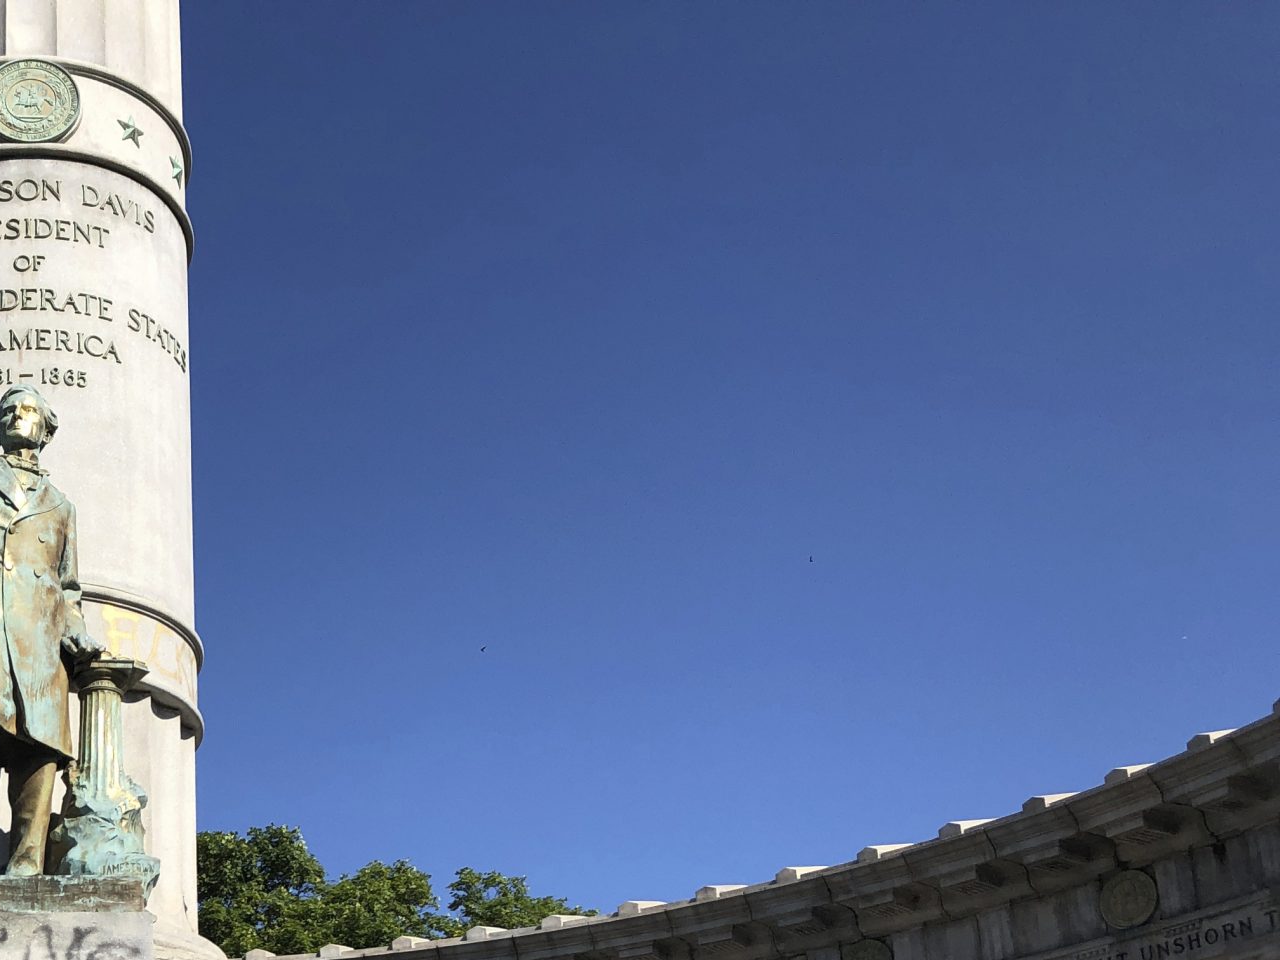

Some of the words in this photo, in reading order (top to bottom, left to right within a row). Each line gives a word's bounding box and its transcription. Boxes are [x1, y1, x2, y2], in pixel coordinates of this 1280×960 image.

[81, 184, 155, 234] DAVIS
[13, 255, 45, 272] OF
[128, 309, 186, 374] STATES
